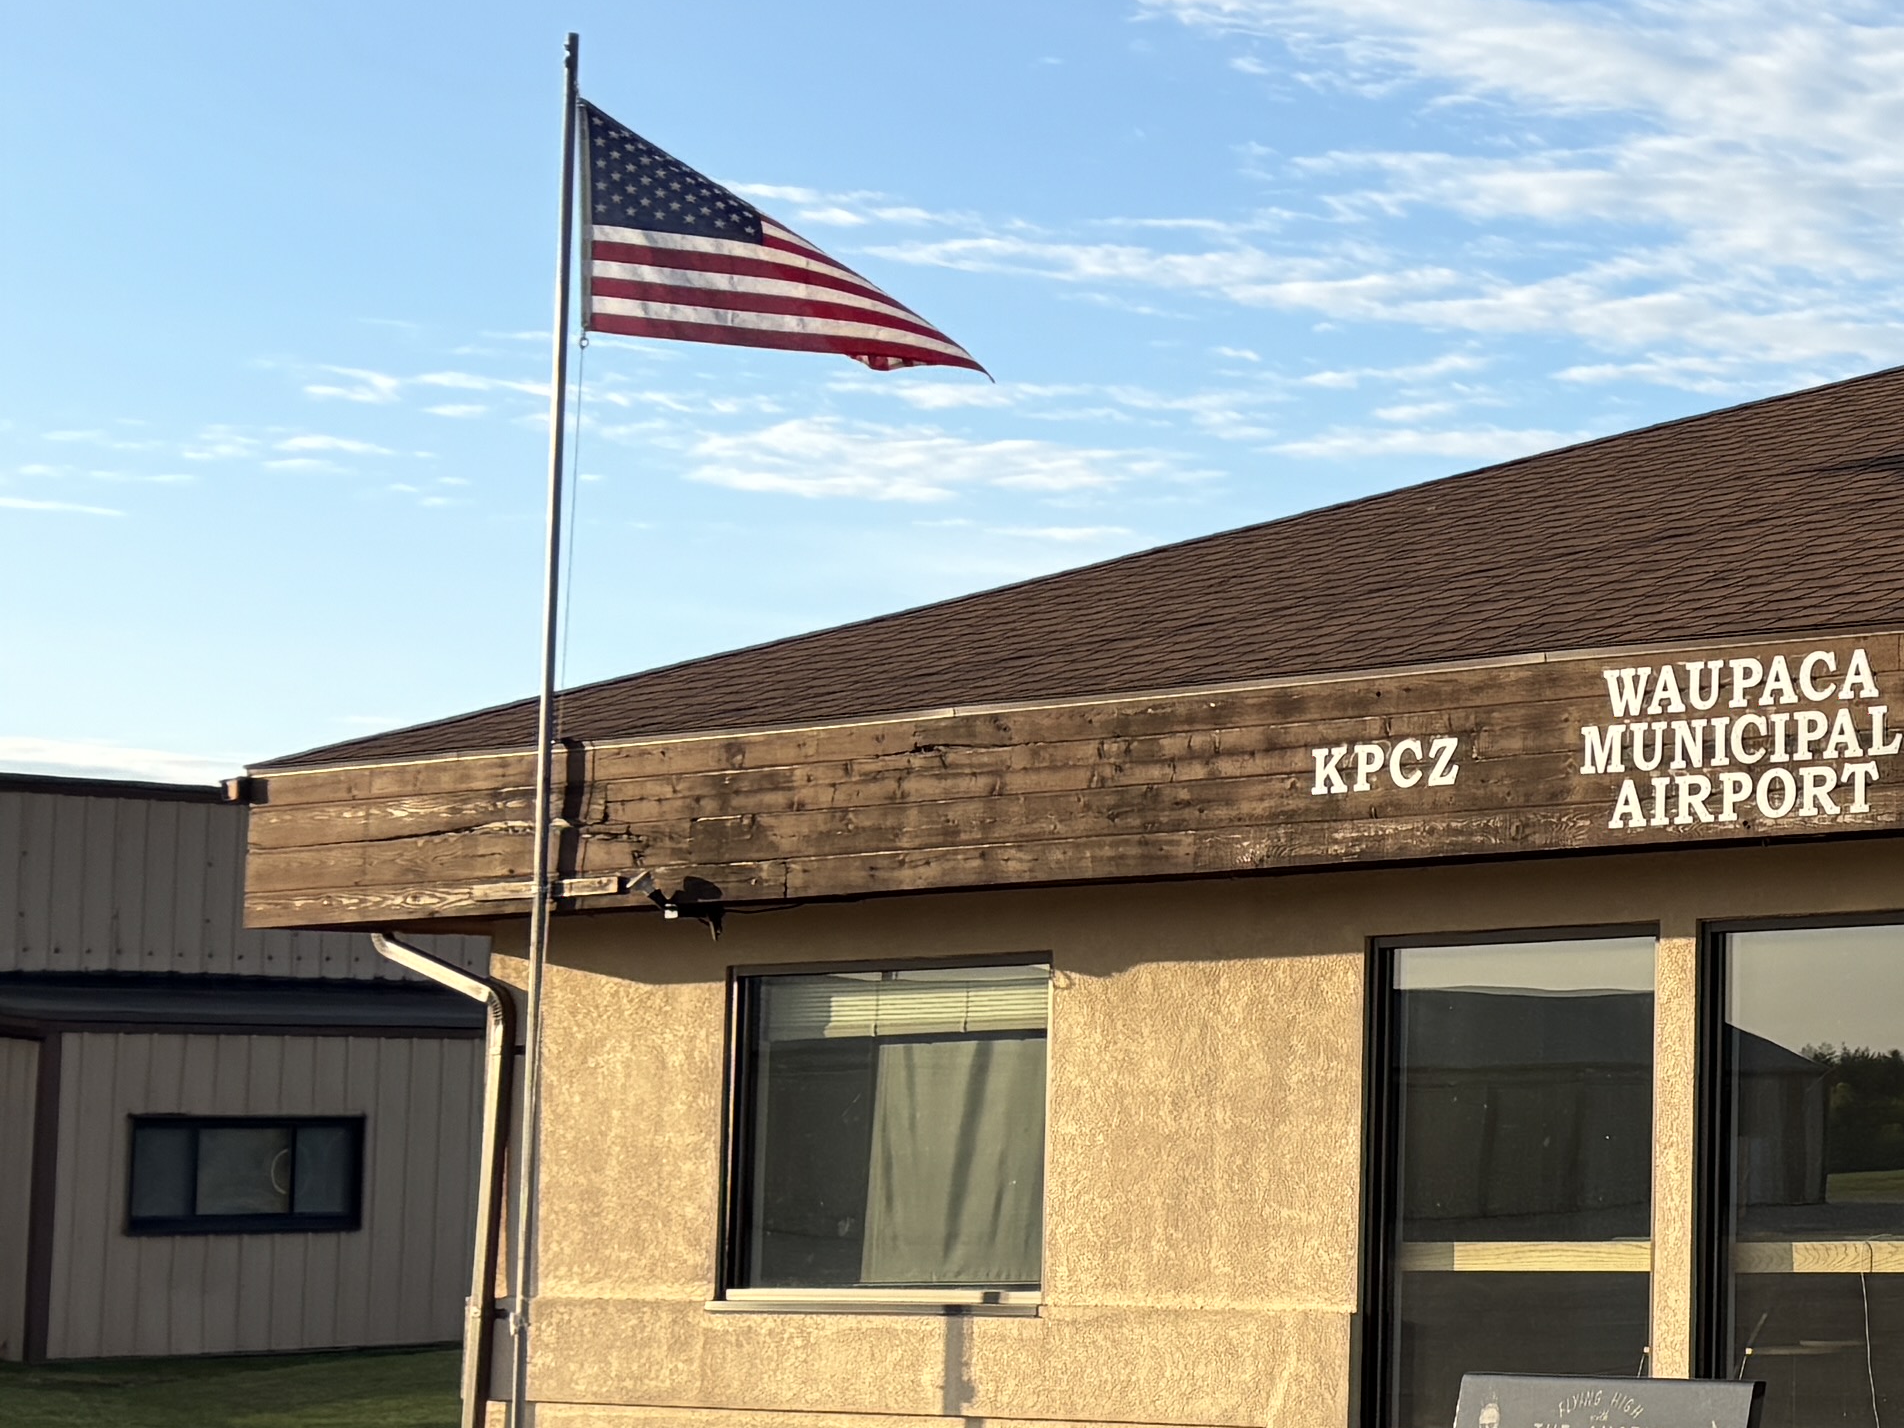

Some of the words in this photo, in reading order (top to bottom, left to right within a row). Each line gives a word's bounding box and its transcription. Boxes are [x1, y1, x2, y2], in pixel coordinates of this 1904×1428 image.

[1603, 648, 1880, 718] WAUPACA
[1311, 737, 1460, 795] KPCZ
[1580, 705, 1903, 775] MUNICIPAL
[1608, 761, 1880, 830] AIRPORT
[1558, 1389, 1603, 1418] FLYING
[1610, 1391, 1644, 1420] HIGH
